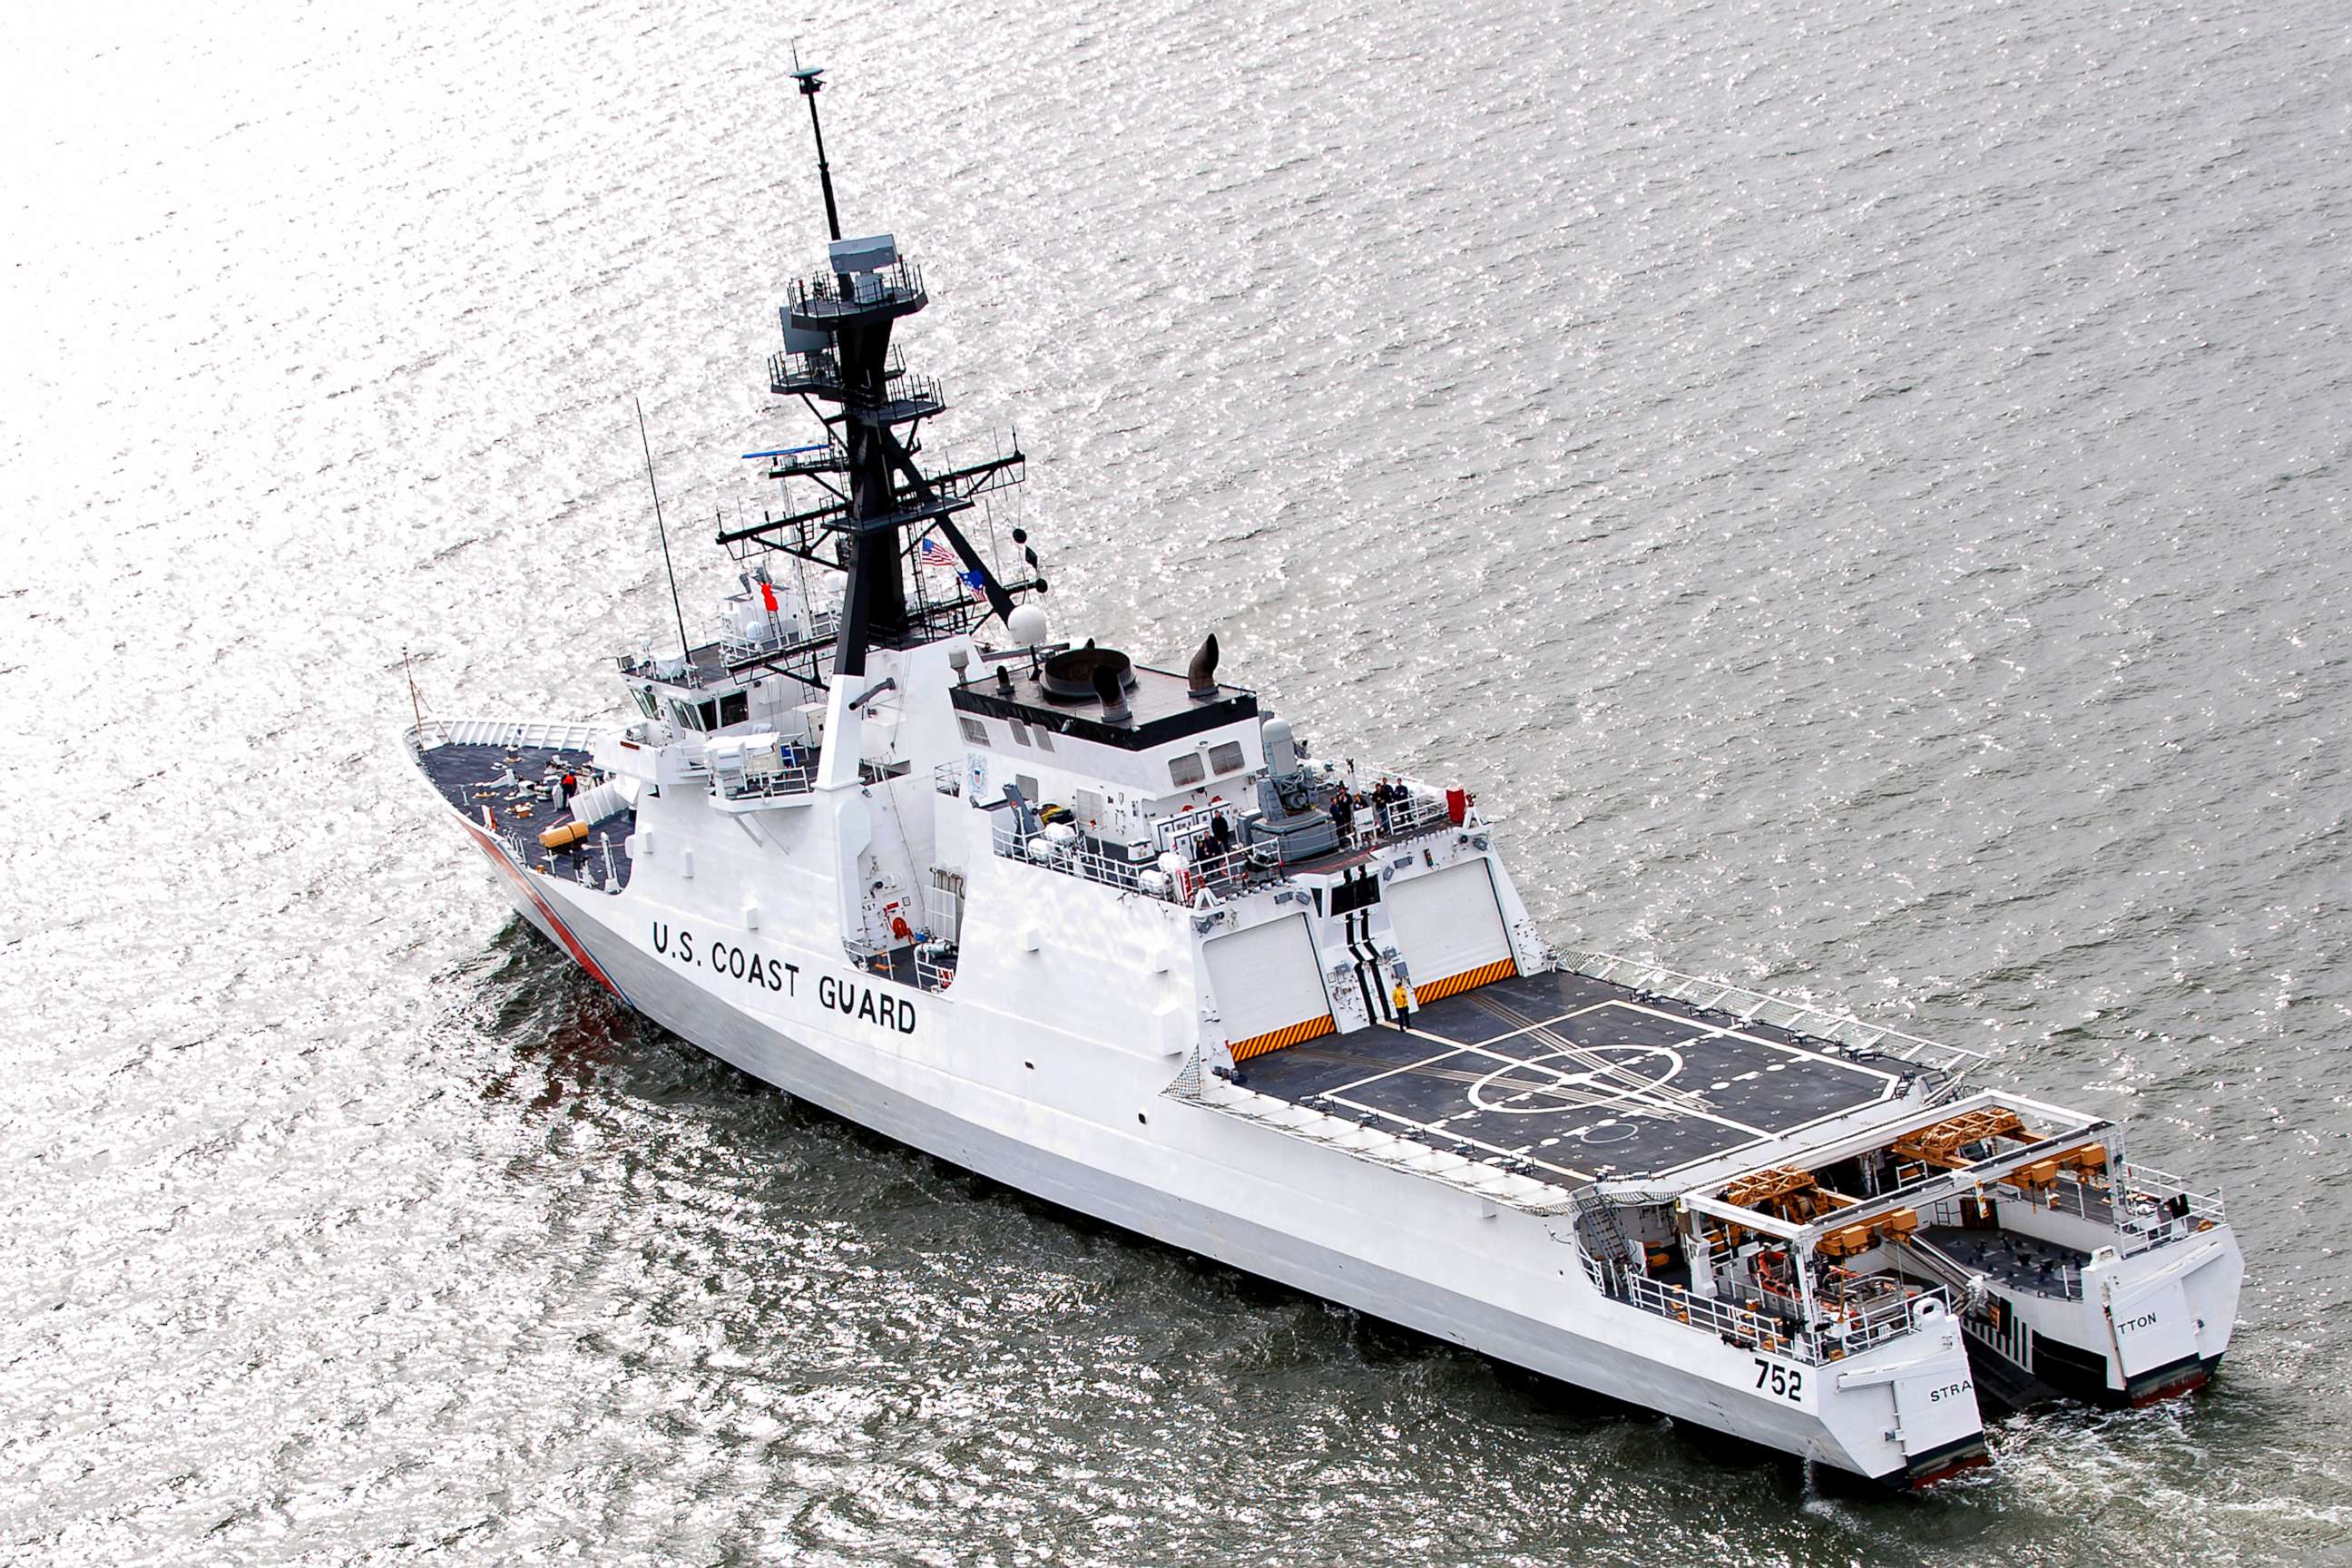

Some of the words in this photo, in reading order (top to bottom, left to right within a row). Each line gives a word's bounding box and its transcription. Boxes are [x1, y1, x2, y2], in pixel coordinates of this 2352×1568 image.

[652, 921, 701, 966] U.S.
[711, 942, 799, 996] COAST
[818, 975, 916, 1034] GUARD
[2117, 1312, 2157, 1335] TTON
[1754, 1357, 1802, 1402] 752
[1930, 1379, 1973, 1402] STRA
